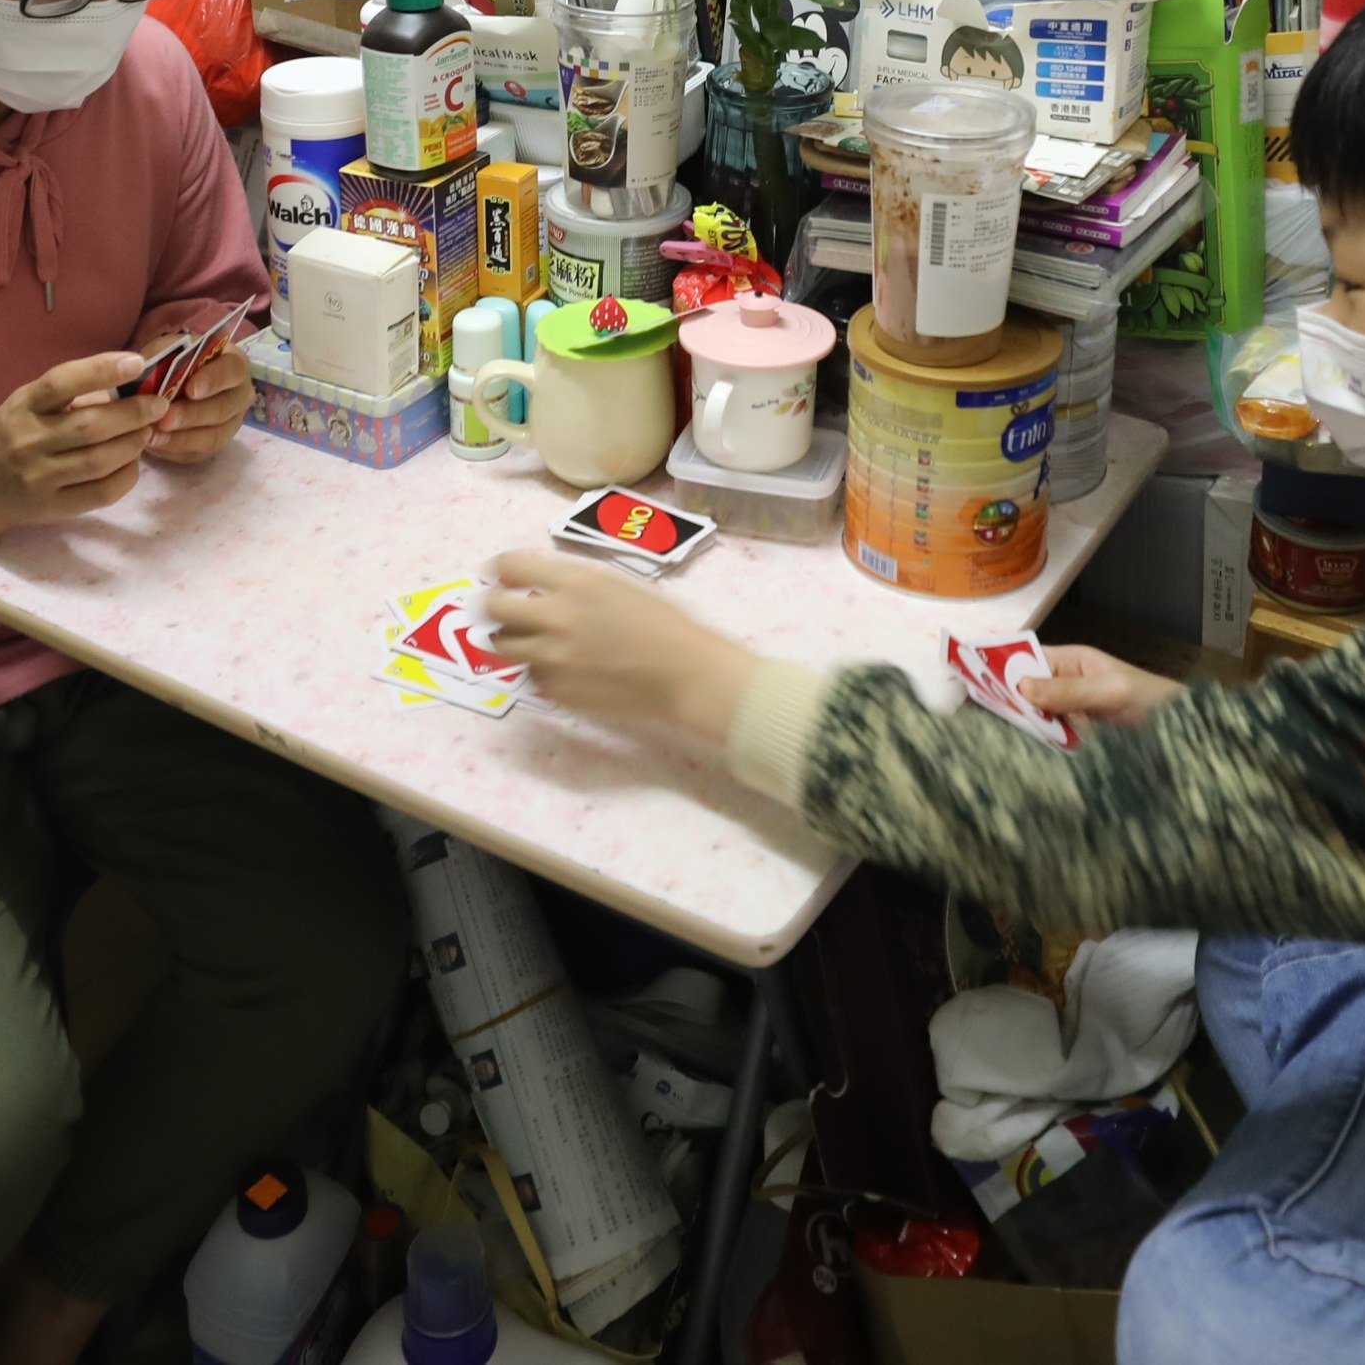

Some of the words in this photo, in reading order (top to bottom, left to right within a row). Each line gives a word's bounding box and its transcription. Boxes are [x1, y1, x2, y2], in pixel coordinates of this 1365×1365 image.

[897, 0, 935, 22] LHM
[502, 49, 538, 62] Mask
[439, 62, 472, 83] CROQUER
[876, 64, 896, 77] 3-PLY
[897, 66, 930, 82] MEDICAL
[444, 75, 464, 112] C
[1050, 103, 1091, 117] 香港製造
[424, 140, 443, 155] PRIME
[268, 199, 331, 226] Walch
[617, 505, 655, 540] UNO
